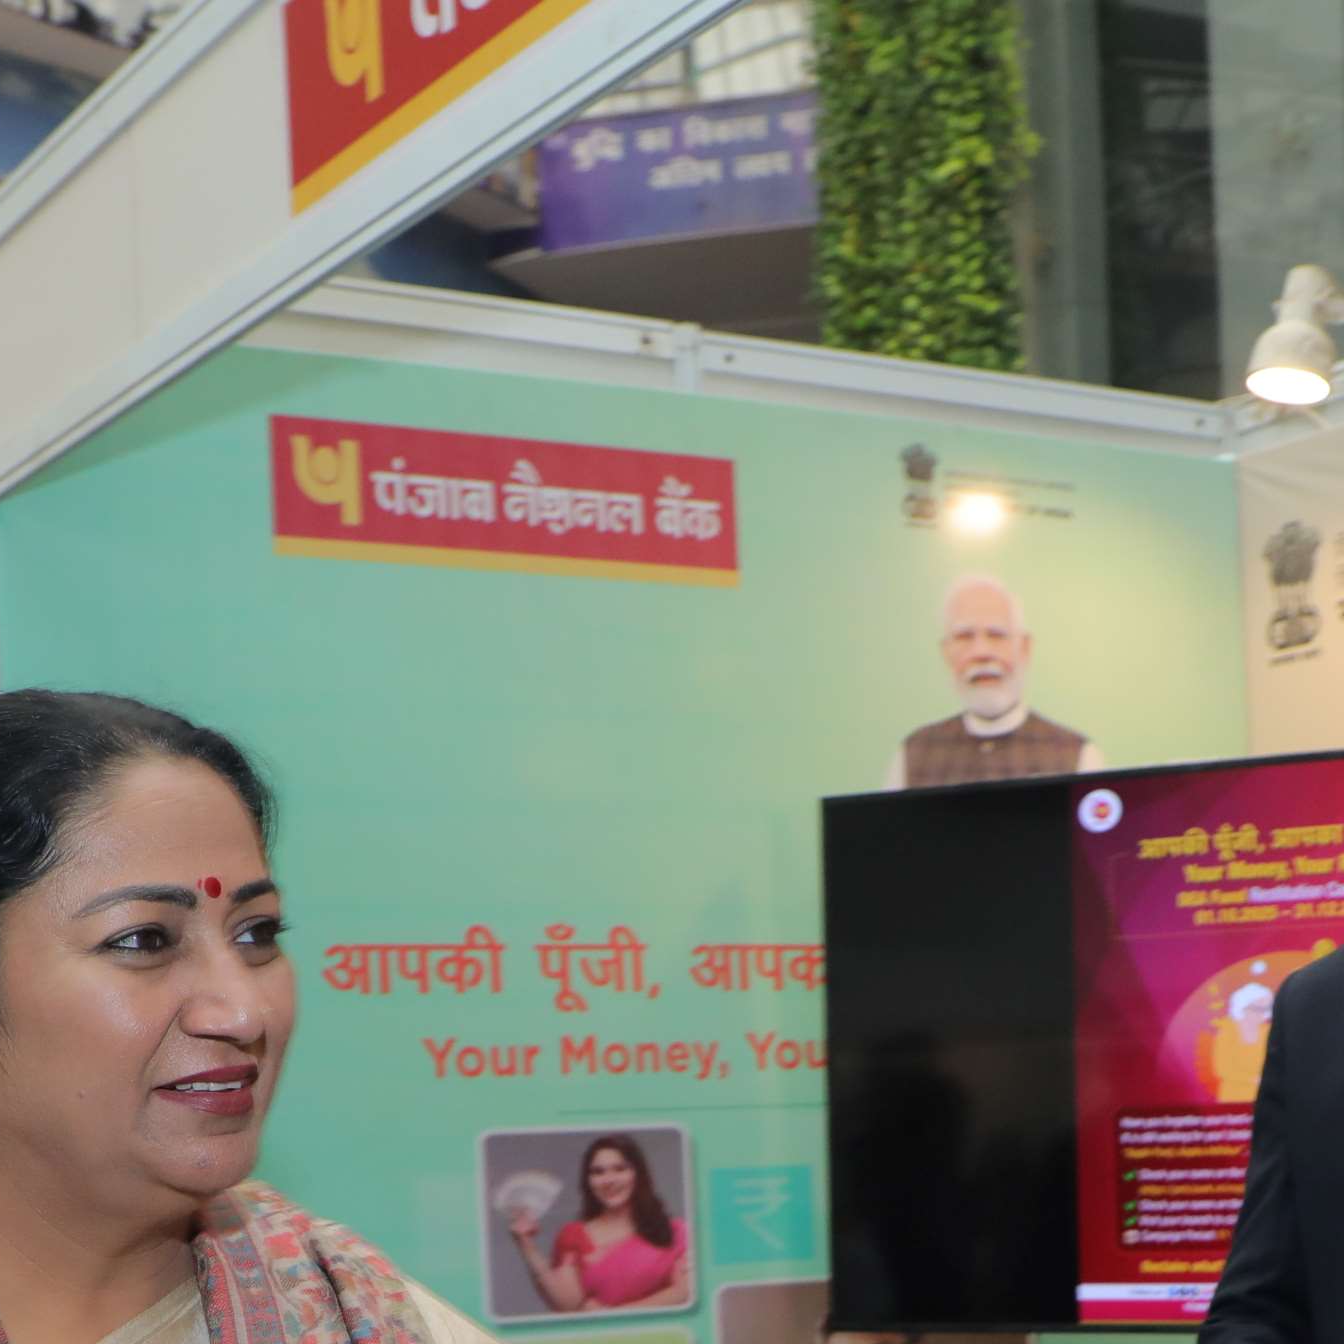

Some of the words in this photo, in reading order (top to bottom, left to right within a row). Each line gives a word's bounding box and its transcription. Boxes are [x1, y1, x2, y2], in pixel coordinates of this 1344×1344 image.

[370, 458, 495, 522] पंजाब
[654, 476, 721, 540] बैंक
[321, 924, 506, 996] आपकी
[533, 924, 660, 1013] पूँजी,
[688, 943, 827, 992] आपक
[422, 1037, 540, 1078] Your
[560, 1035, 730, 1079] Money,
[746, 1031, 827, 1071] You
